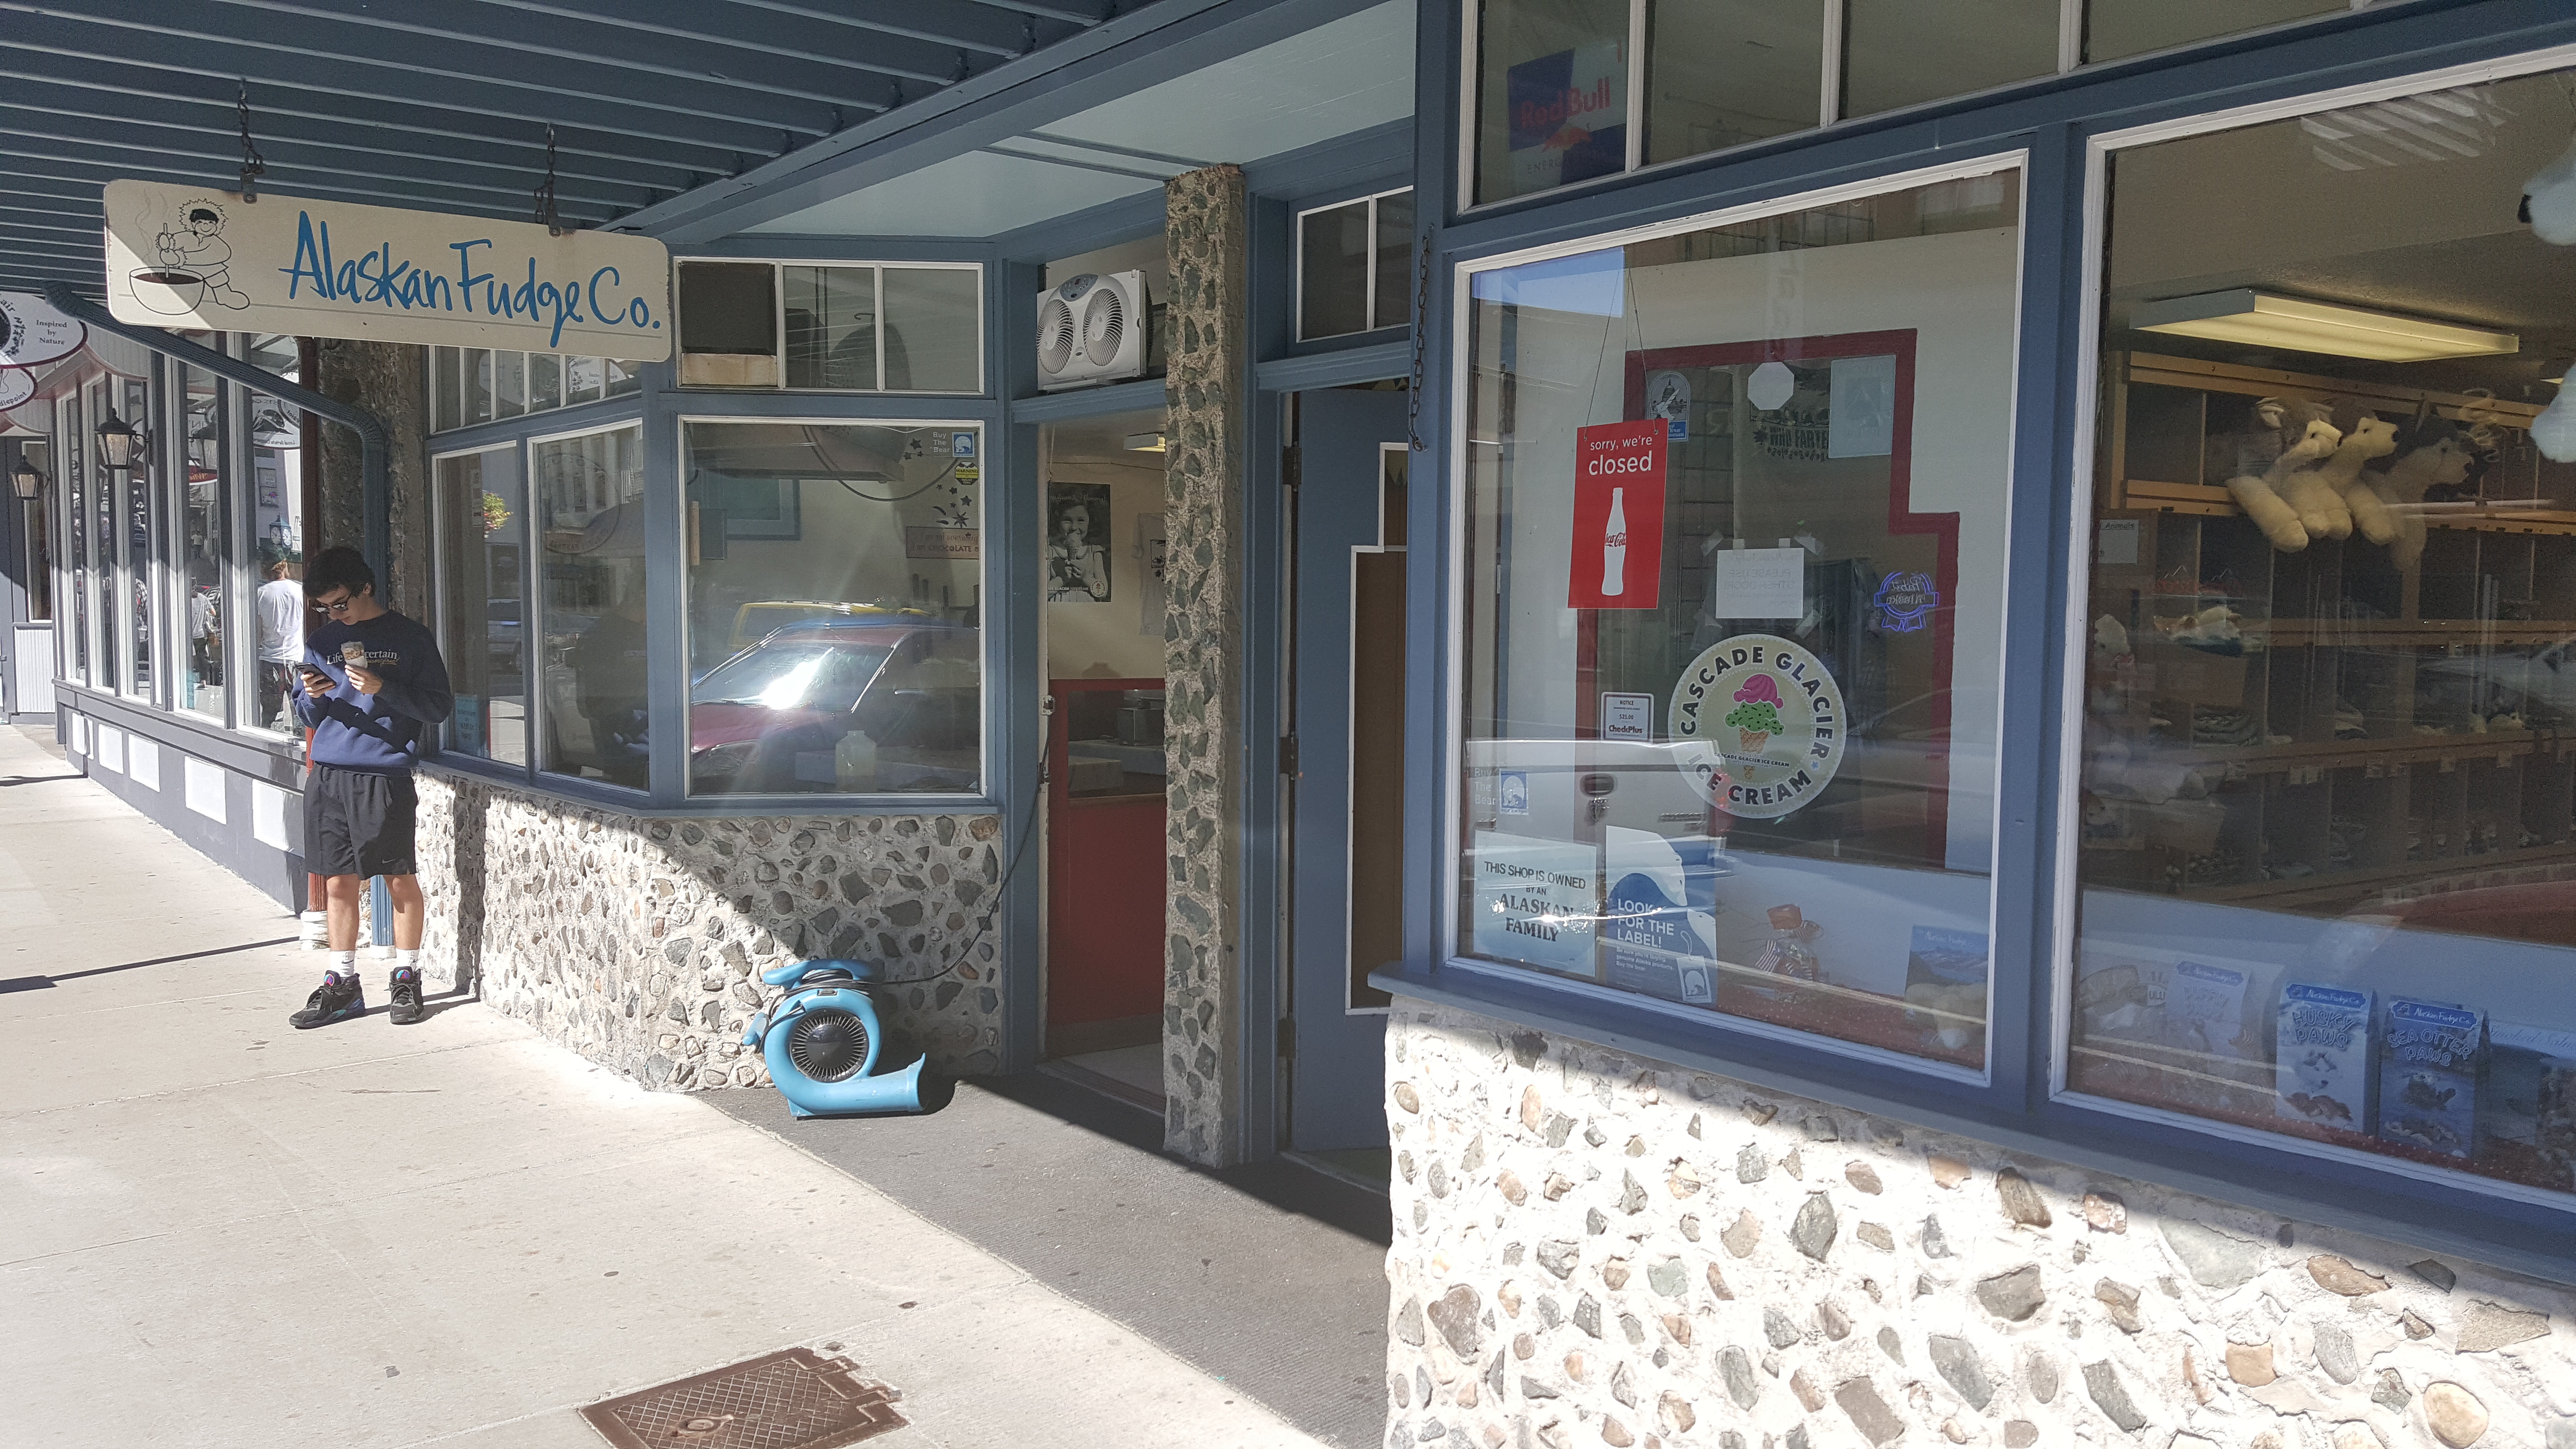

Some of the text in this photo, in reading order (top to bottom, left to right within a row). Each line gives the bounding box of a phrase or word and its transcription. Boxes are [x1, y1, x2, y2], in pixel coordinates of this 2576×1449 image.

[1567, 77, 1610, 117] Bull
[1528, 157, 1561, 174] ENERG
[278, 210, 660, 348] Alaskan Fudge Co.
[36, 320, 67, 328] Inspired
[1590, 435, 1652, 451] sorry, we're
[1589, 451, 1652, 475] closed
[326, 649, 397, 664] Life certain
[1680, 646, 1833, 759] CASCADE GLACIER
[1609, 724, 1643, 734] CheckPlus
[1474, 767, 1492, 780] Buy
[1687, 753, 1812, 805] ICE CREAM
[1474, 781, 1491, 791] The
[1475, 794, 1496, 805] Bear
[1484, 861, 1586, 889] THIS SHOP IS OWNED
[1536, 887, 1546, 896] AN
[1499, 893, 1574, 917] ALASKAN
[1618, 898, 1654, 914] LOOK
[1505, 917, 1560, 942] FAMILY
[1618, 913, 1674, 936] FOR THE
[1617, 928, 1662, 949] LABEL!
[2292, 1009, 2355, 1032] HUSKY
[2414, 1007, 2471, 1025] Alaskan Fudge Co.
[2296, 1027, 2348, 1050] PAWS
[2387, 1029, 2472, 1060] SEA OTTER
[2405, 1046, 2451, 1066] PAWS
